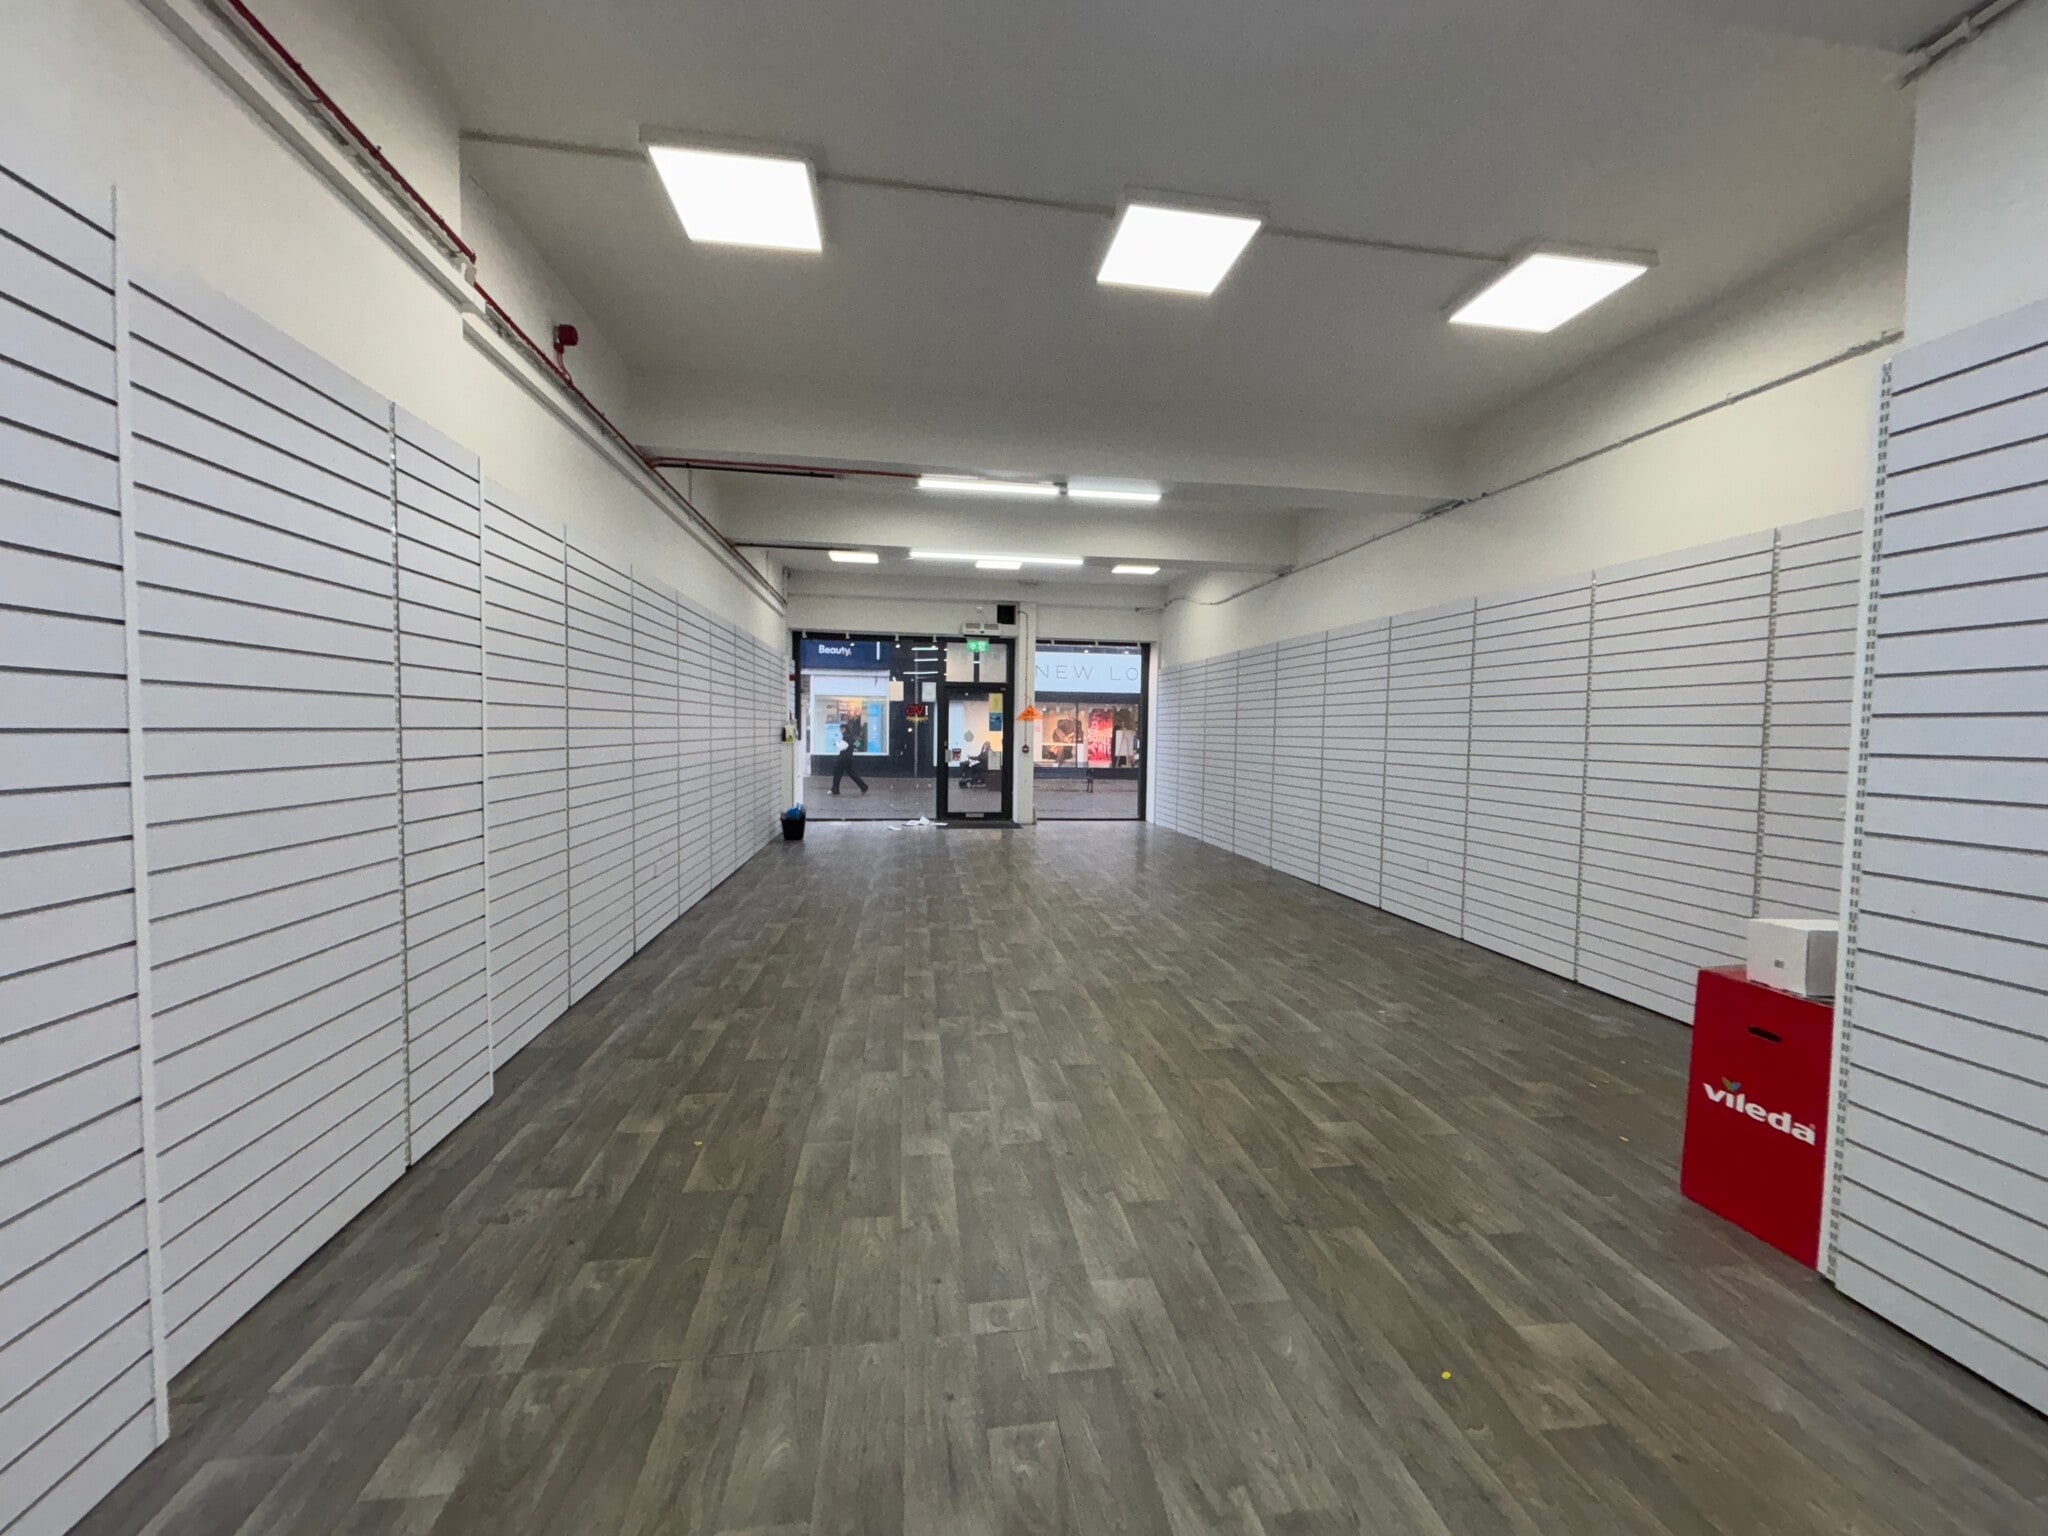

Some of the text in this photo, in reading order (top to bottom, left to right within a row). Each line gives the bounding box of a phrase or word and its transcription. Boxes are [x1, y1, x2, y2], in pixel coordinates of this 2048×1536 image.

[1036, 664, 1139, 681] NEW LO
[1702, 1078, 1816, 1146] vileda
